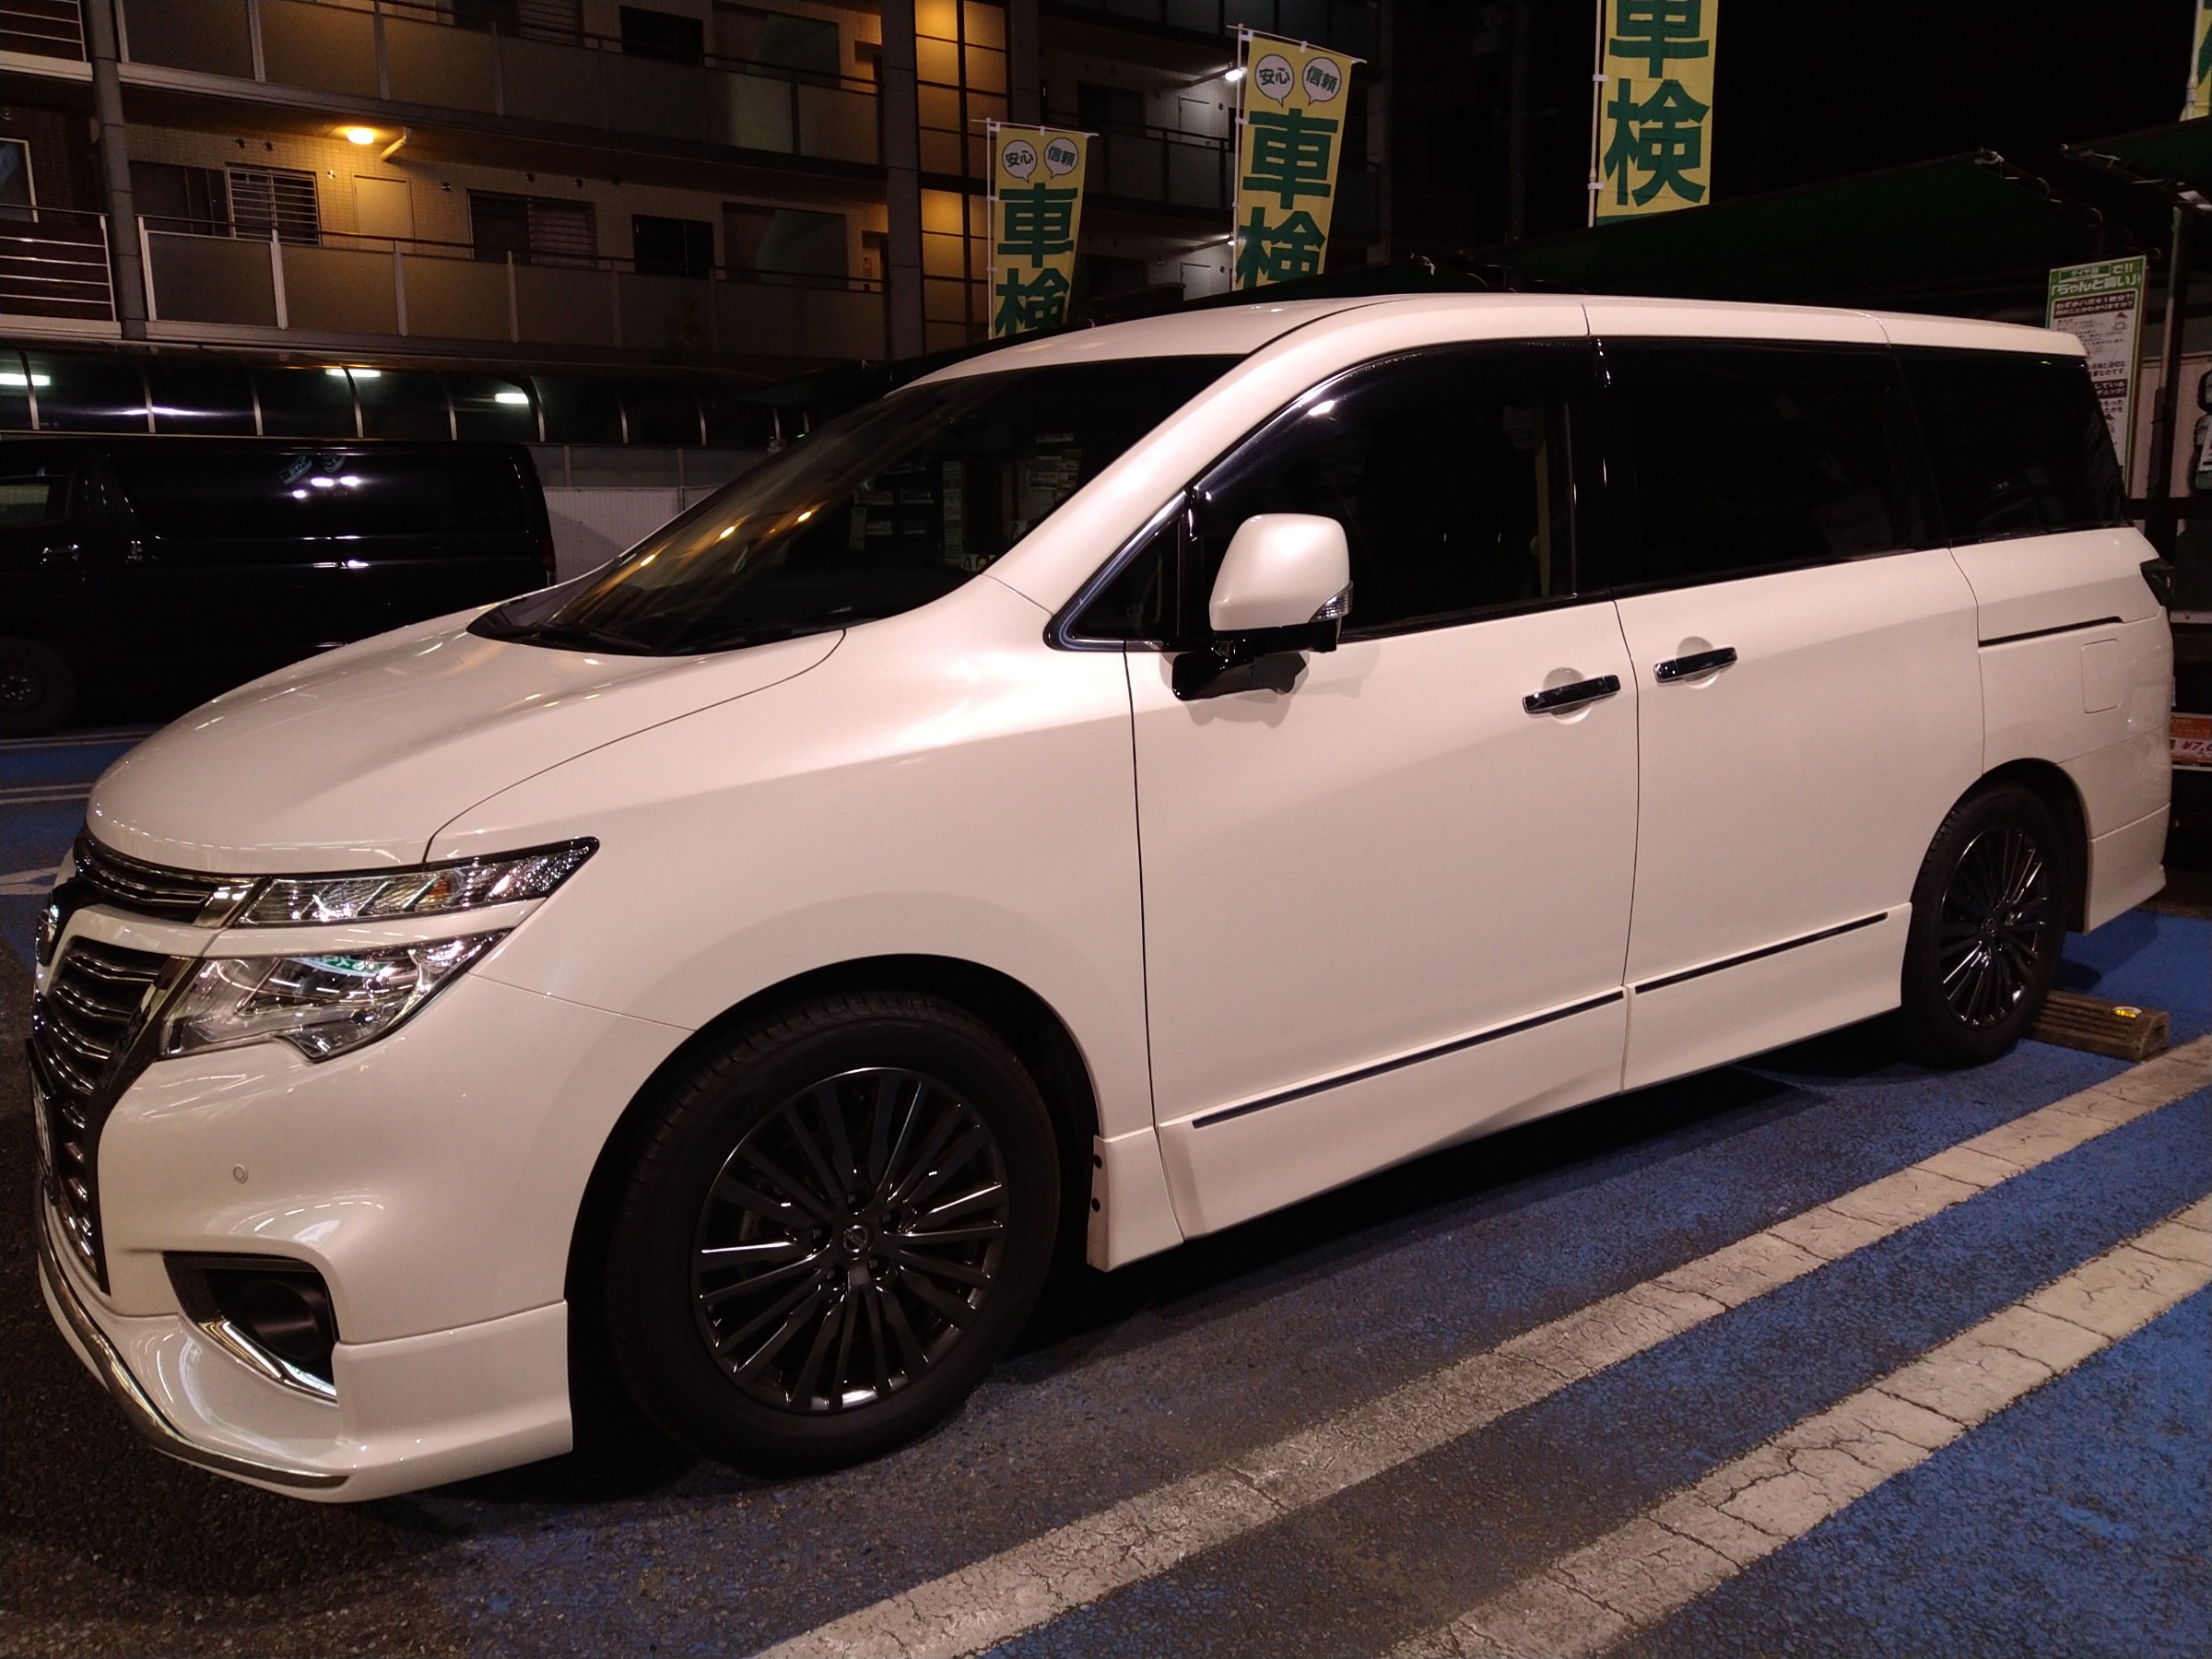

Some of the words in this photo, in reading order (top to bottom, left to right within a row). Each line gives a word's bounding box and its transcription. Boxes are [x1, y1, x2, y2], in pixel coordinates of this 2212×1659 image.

[1258, 67, 1290, 86] 安心
[1305, 65, 1339, 93] 信頼
[1604, 0, 1711, 207] 車検
[1005, 150, 1034, 168] 安心
[1047, 146, 1077, 167] 信頼
[1236, 108, 1339, 288] 車検
[994, 182, 1078, 336] 車検
